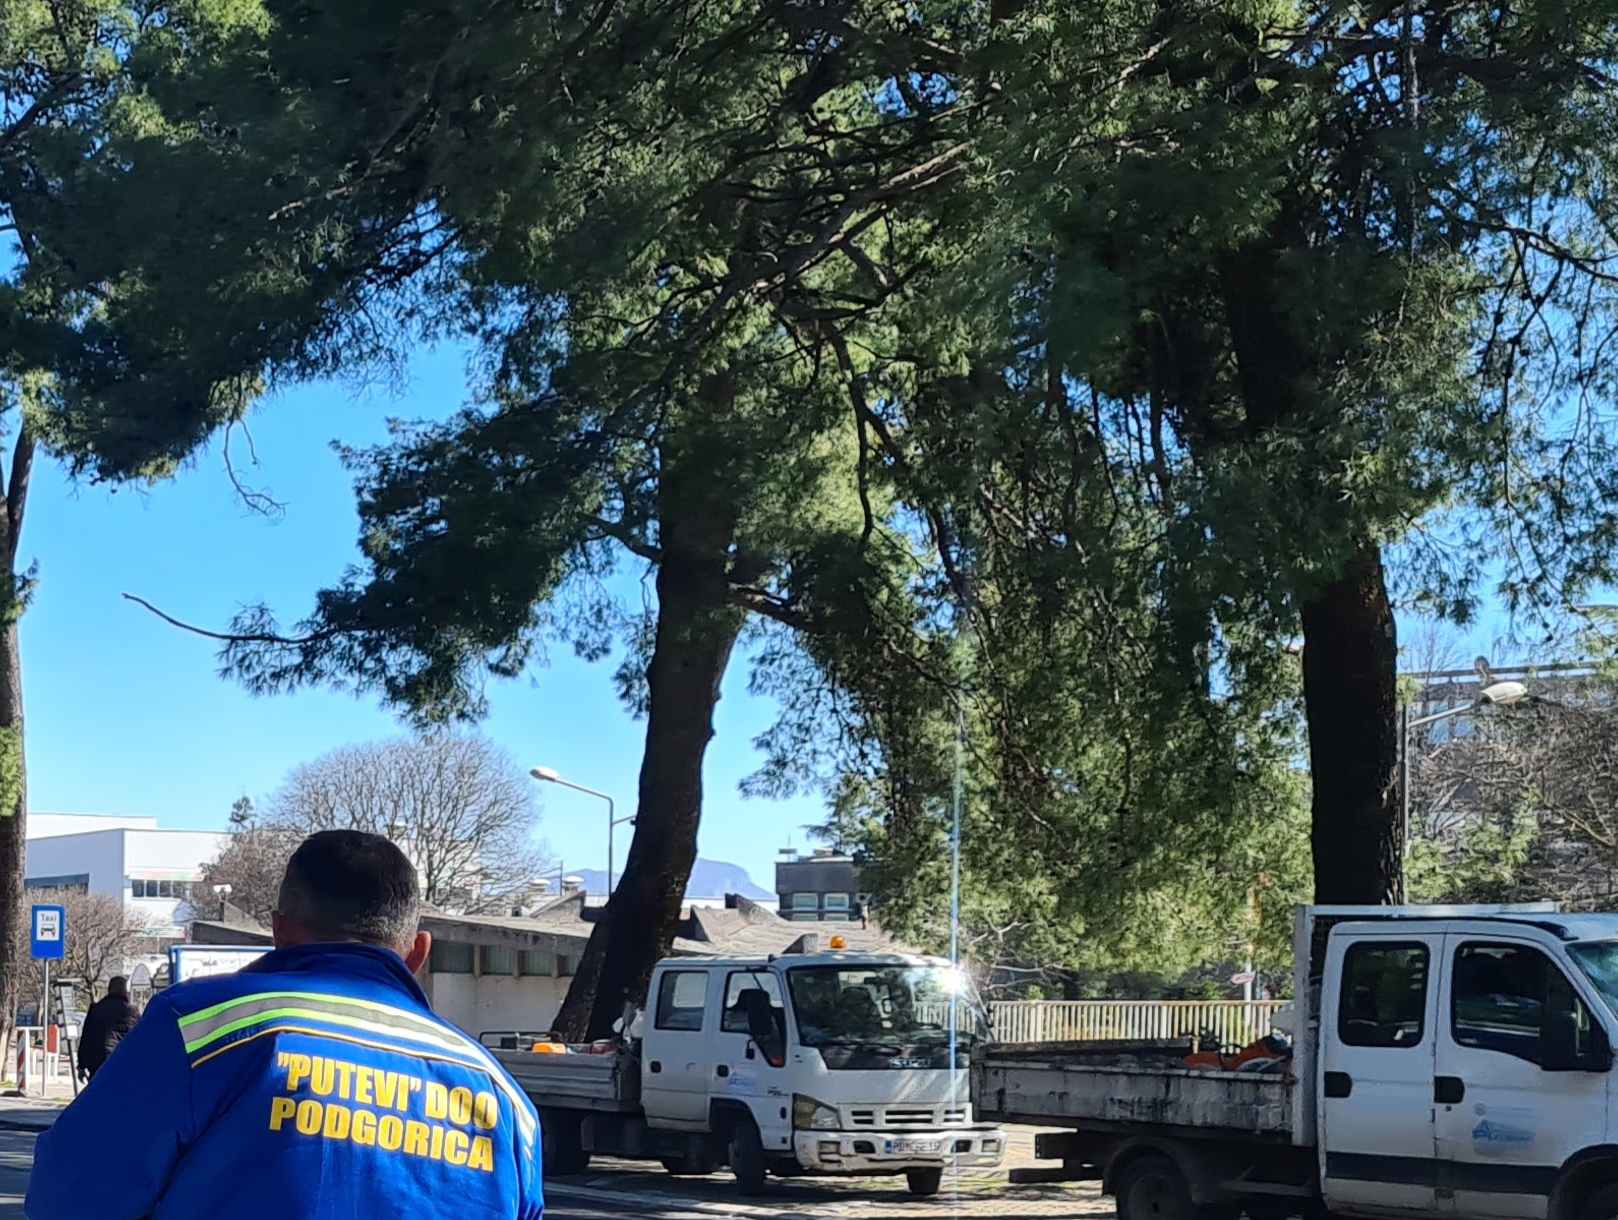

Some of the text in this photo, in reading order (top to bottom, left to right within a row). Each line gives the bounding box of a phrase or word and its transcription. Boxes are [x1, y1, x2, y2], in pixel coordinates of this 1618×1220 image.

[40, 913, 57, 922] Taxi
[425, 1080, 499, 1130] DOO
[269, 1096, 494, 1173] PODGORICA
